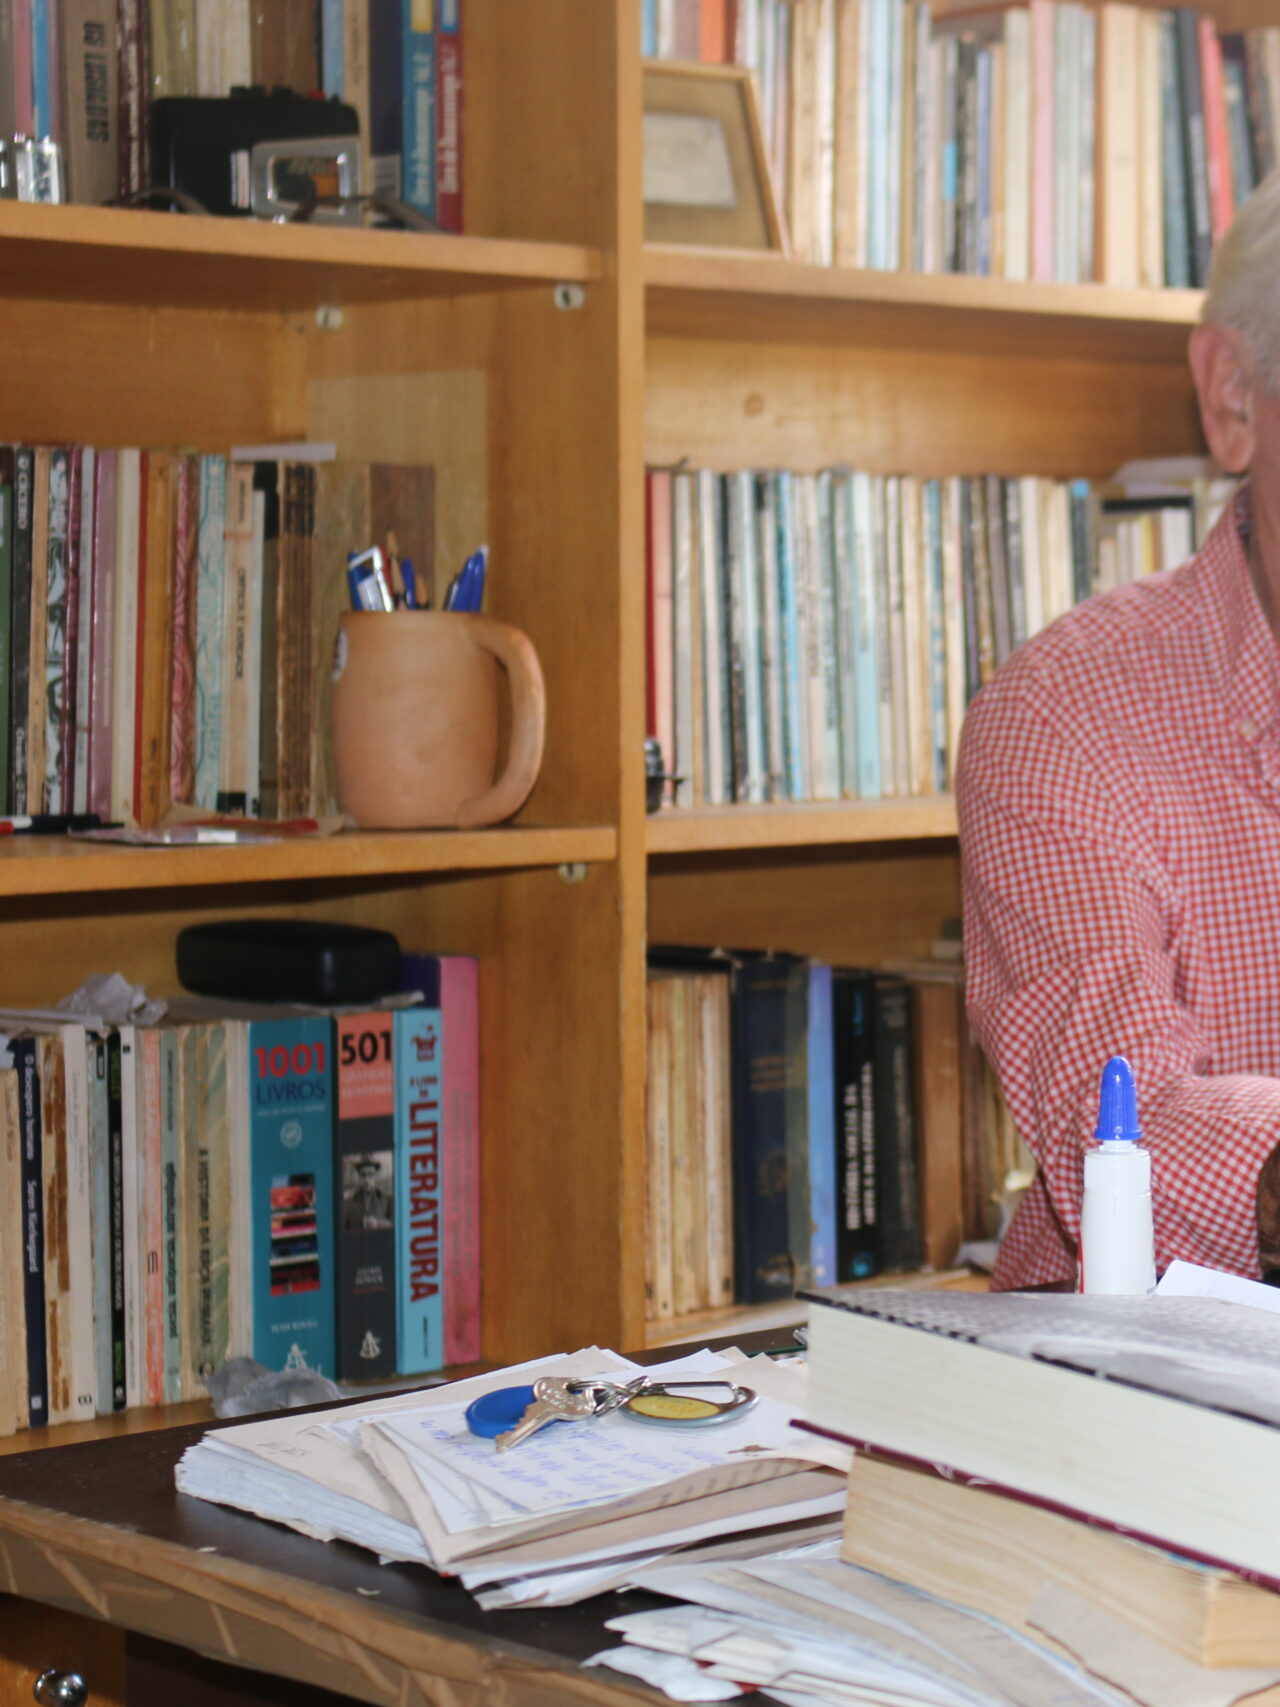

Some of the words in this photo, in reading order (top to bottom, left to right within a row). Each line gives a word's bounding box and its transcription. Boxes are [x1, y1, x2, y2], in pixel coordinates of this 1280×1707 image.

[253, 1041, 326, 1079] 1001
[341, 1030, 393, 1067] 501
[256, 1079, 327, 1105] LIVROS
[409, 1100, 439, 1303] LITERATURA
